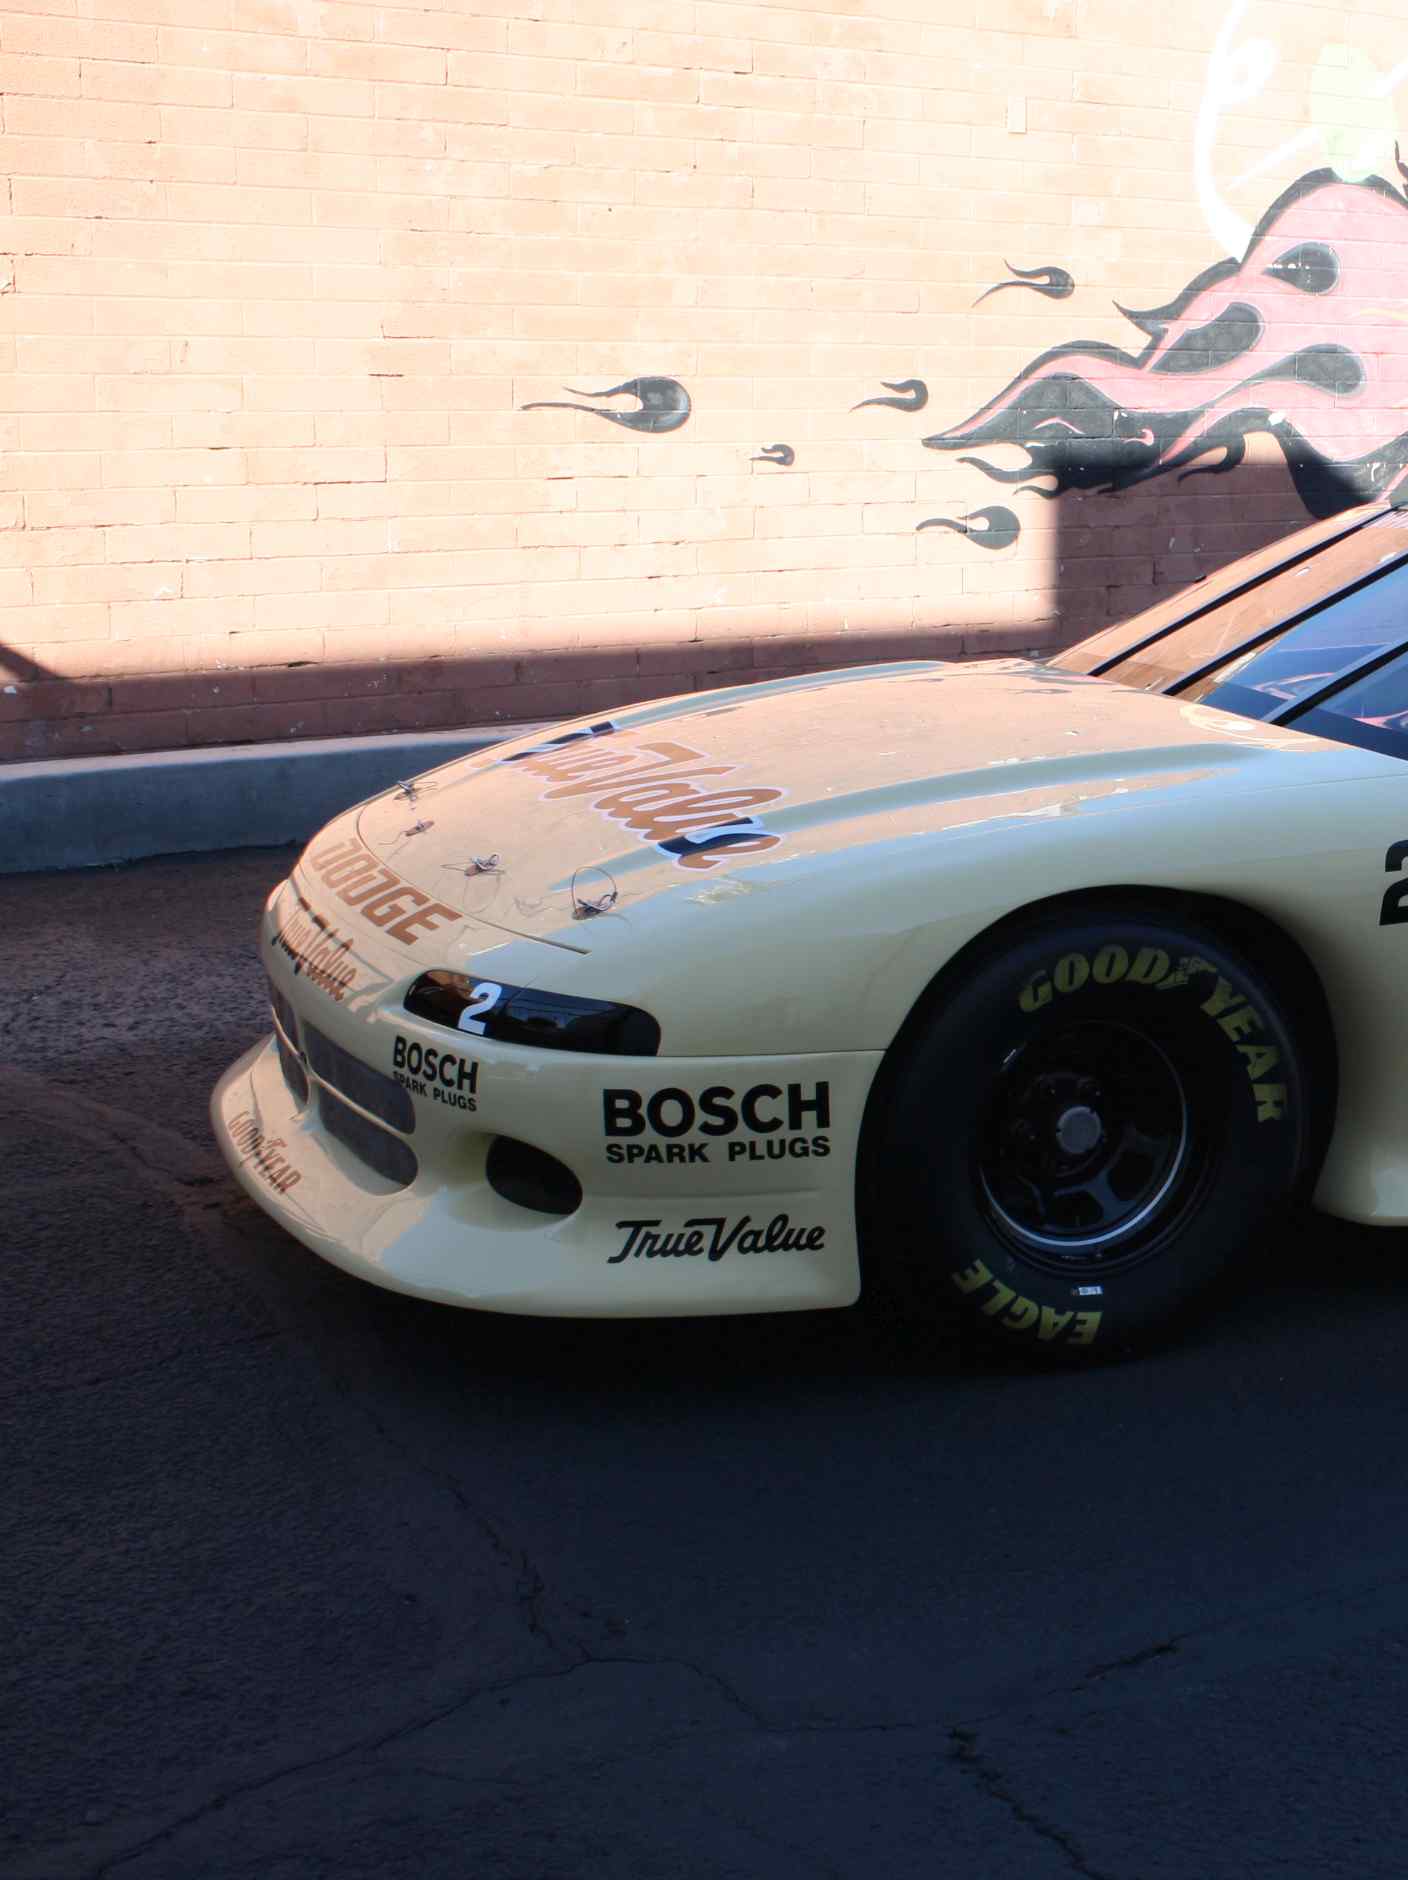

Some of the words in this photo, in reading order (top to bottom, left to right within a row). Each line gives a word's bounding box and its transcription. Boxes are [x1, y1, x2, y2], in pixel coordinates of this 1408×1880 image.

[311, 838, 463, 945] DODGE
[457, 982, 503, 1036] 2
[393, 1034, 479, 1094] BOSCH
[433, 1087, 478, 1112] PLUGS
[603, 1081, 831, 1138] BOSCH
[605, 1143, 710, 1164] SPARK
[727, 1135, 832, 1162] PLUGS
[951, 1259, 1103, 1345] EAGLE
